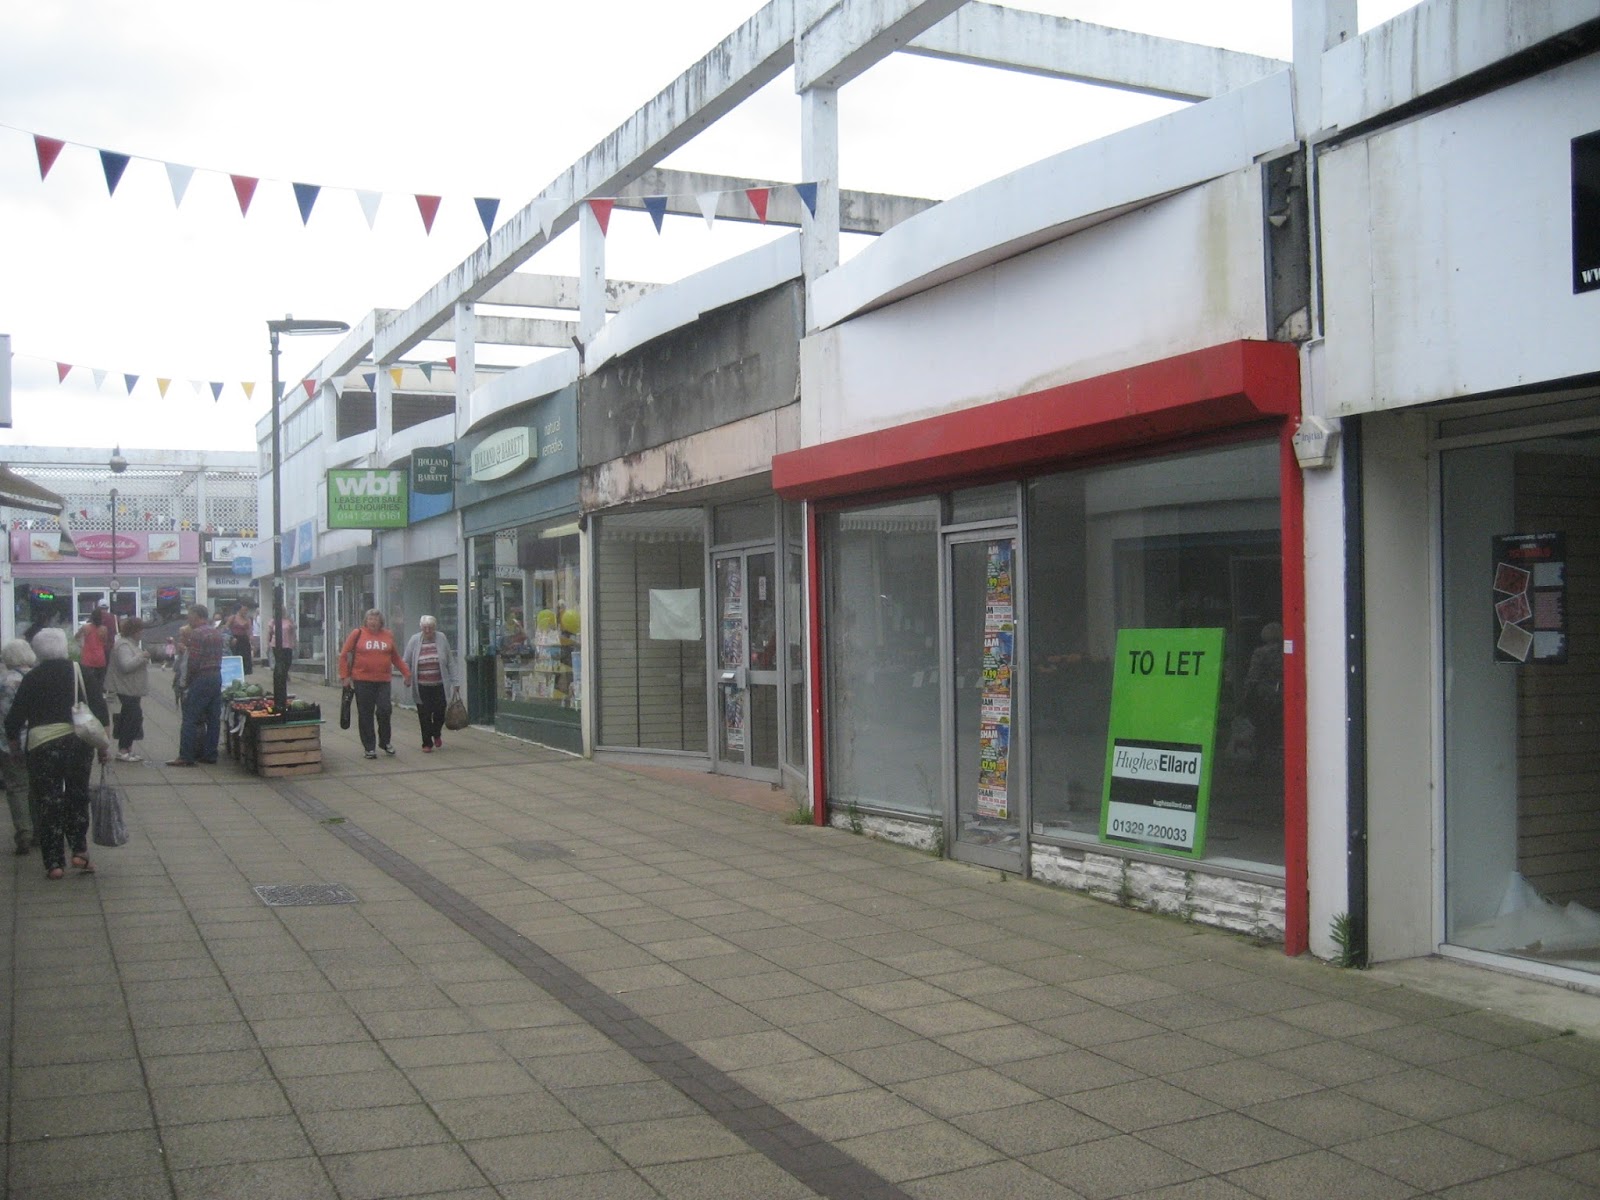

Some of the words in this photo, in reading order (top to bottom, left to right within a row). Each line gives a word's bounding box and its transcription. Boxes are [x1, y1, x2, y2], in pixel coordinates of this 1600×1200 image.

[417, 457, 449, 468] HOLLAND
[429, 466, 437, 474] &
[417, 473, 448, 483] BARRETT
[335, 471, 401, 496] wbf
[334, 496, 361, 504] LEASE
[362, 496, 380, 504] FOR
[382, 496, 403, 504] SALE
[337, 503, 353, 511] ALL
[355, 503, 400, 511] ENQUIRIES
[360, 511, 377, 520] 221
[379, 511, 401, 520] 6161
[215, 577, 240, 585] Blinds
[365, 640, 388, 651] GAP
[1129, 650, 1155, 676] TO
[1165, 651, 1205, 676] LET
[1112, 818, 1145, 835] 01329
[1147, 824, 1187, 842] 220033
